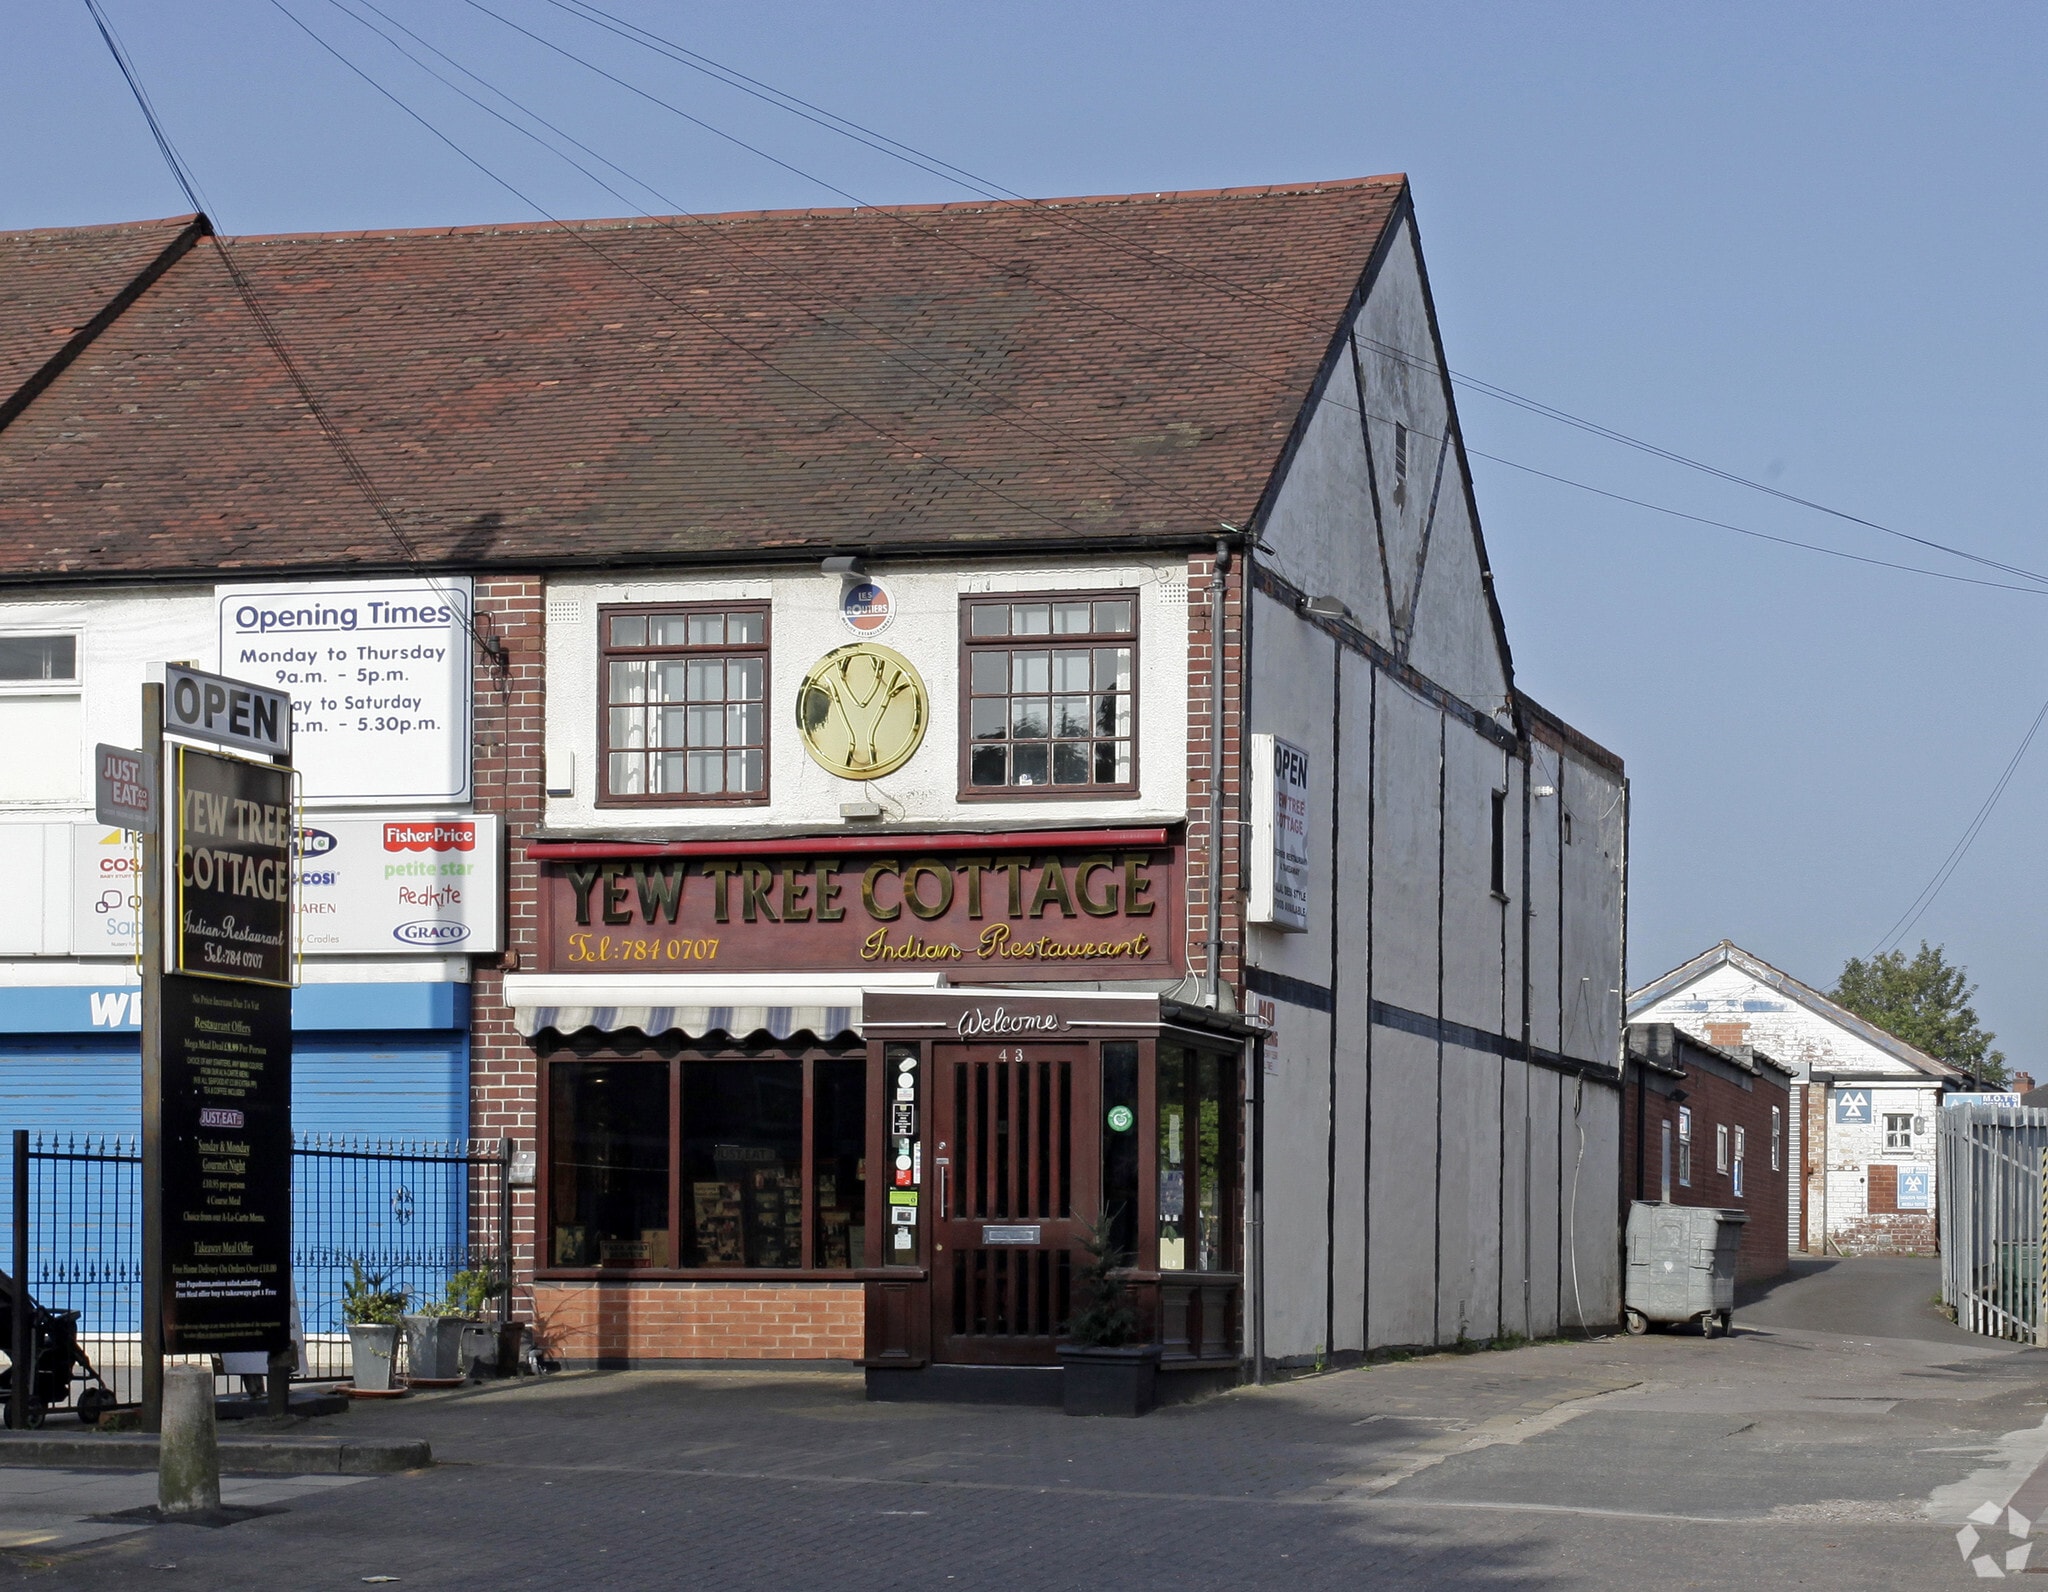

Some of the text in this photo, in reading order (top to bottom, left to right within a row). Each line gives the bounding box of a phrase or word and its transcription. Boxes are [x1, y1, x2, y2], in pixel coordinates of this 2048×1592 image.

[858, 591, 872, 601] LES
[236, 601, 451, 634] Opening Times
[846, 604, 887, 615] ROUTIERS
[240, 645, 446, 665] Monday to Thursday
[276, 669, 328, 684] 9a.m.
[357, 668, 409, 686] 5p.m.
[174, 677, 278, 743] OPEN
[321, 697, 338, 710] to
[345, 694, 422, 713] Saturday
[357, 717, 441, 735] 5.30p.m.
[104, 757, 139, 783] JUST
[1275, 745, 1308, 790] OPEN
[113, 781, 138, 806] EAT
[1288, 796, 1306, 816] TREE
[177, 789, 288, 848] YEW TREE
[178, 845, 288, 902] COTTAGE
[385, 860, 475, 880] petite star
[399, 884, 462, 909] Redkite
[564, 853, 1155, 924] YEW TREE COTTAGE
[183, 909, 285, 946] Indian Restaurant
[405, 926, 464, 939] GRACO
[306, 934, 340, 944] Cradles
[666, 939, 720, 961] 0707
[860, 923, 1150, 960] Indian Restaurant
[194, 1016, 251, 1034] Restaurant Offers
[957, 1006, 1059, 1037] Welcome
[202, 1111, 221, 1124] JUST
[222, 1112, 238, 1125] EAT
